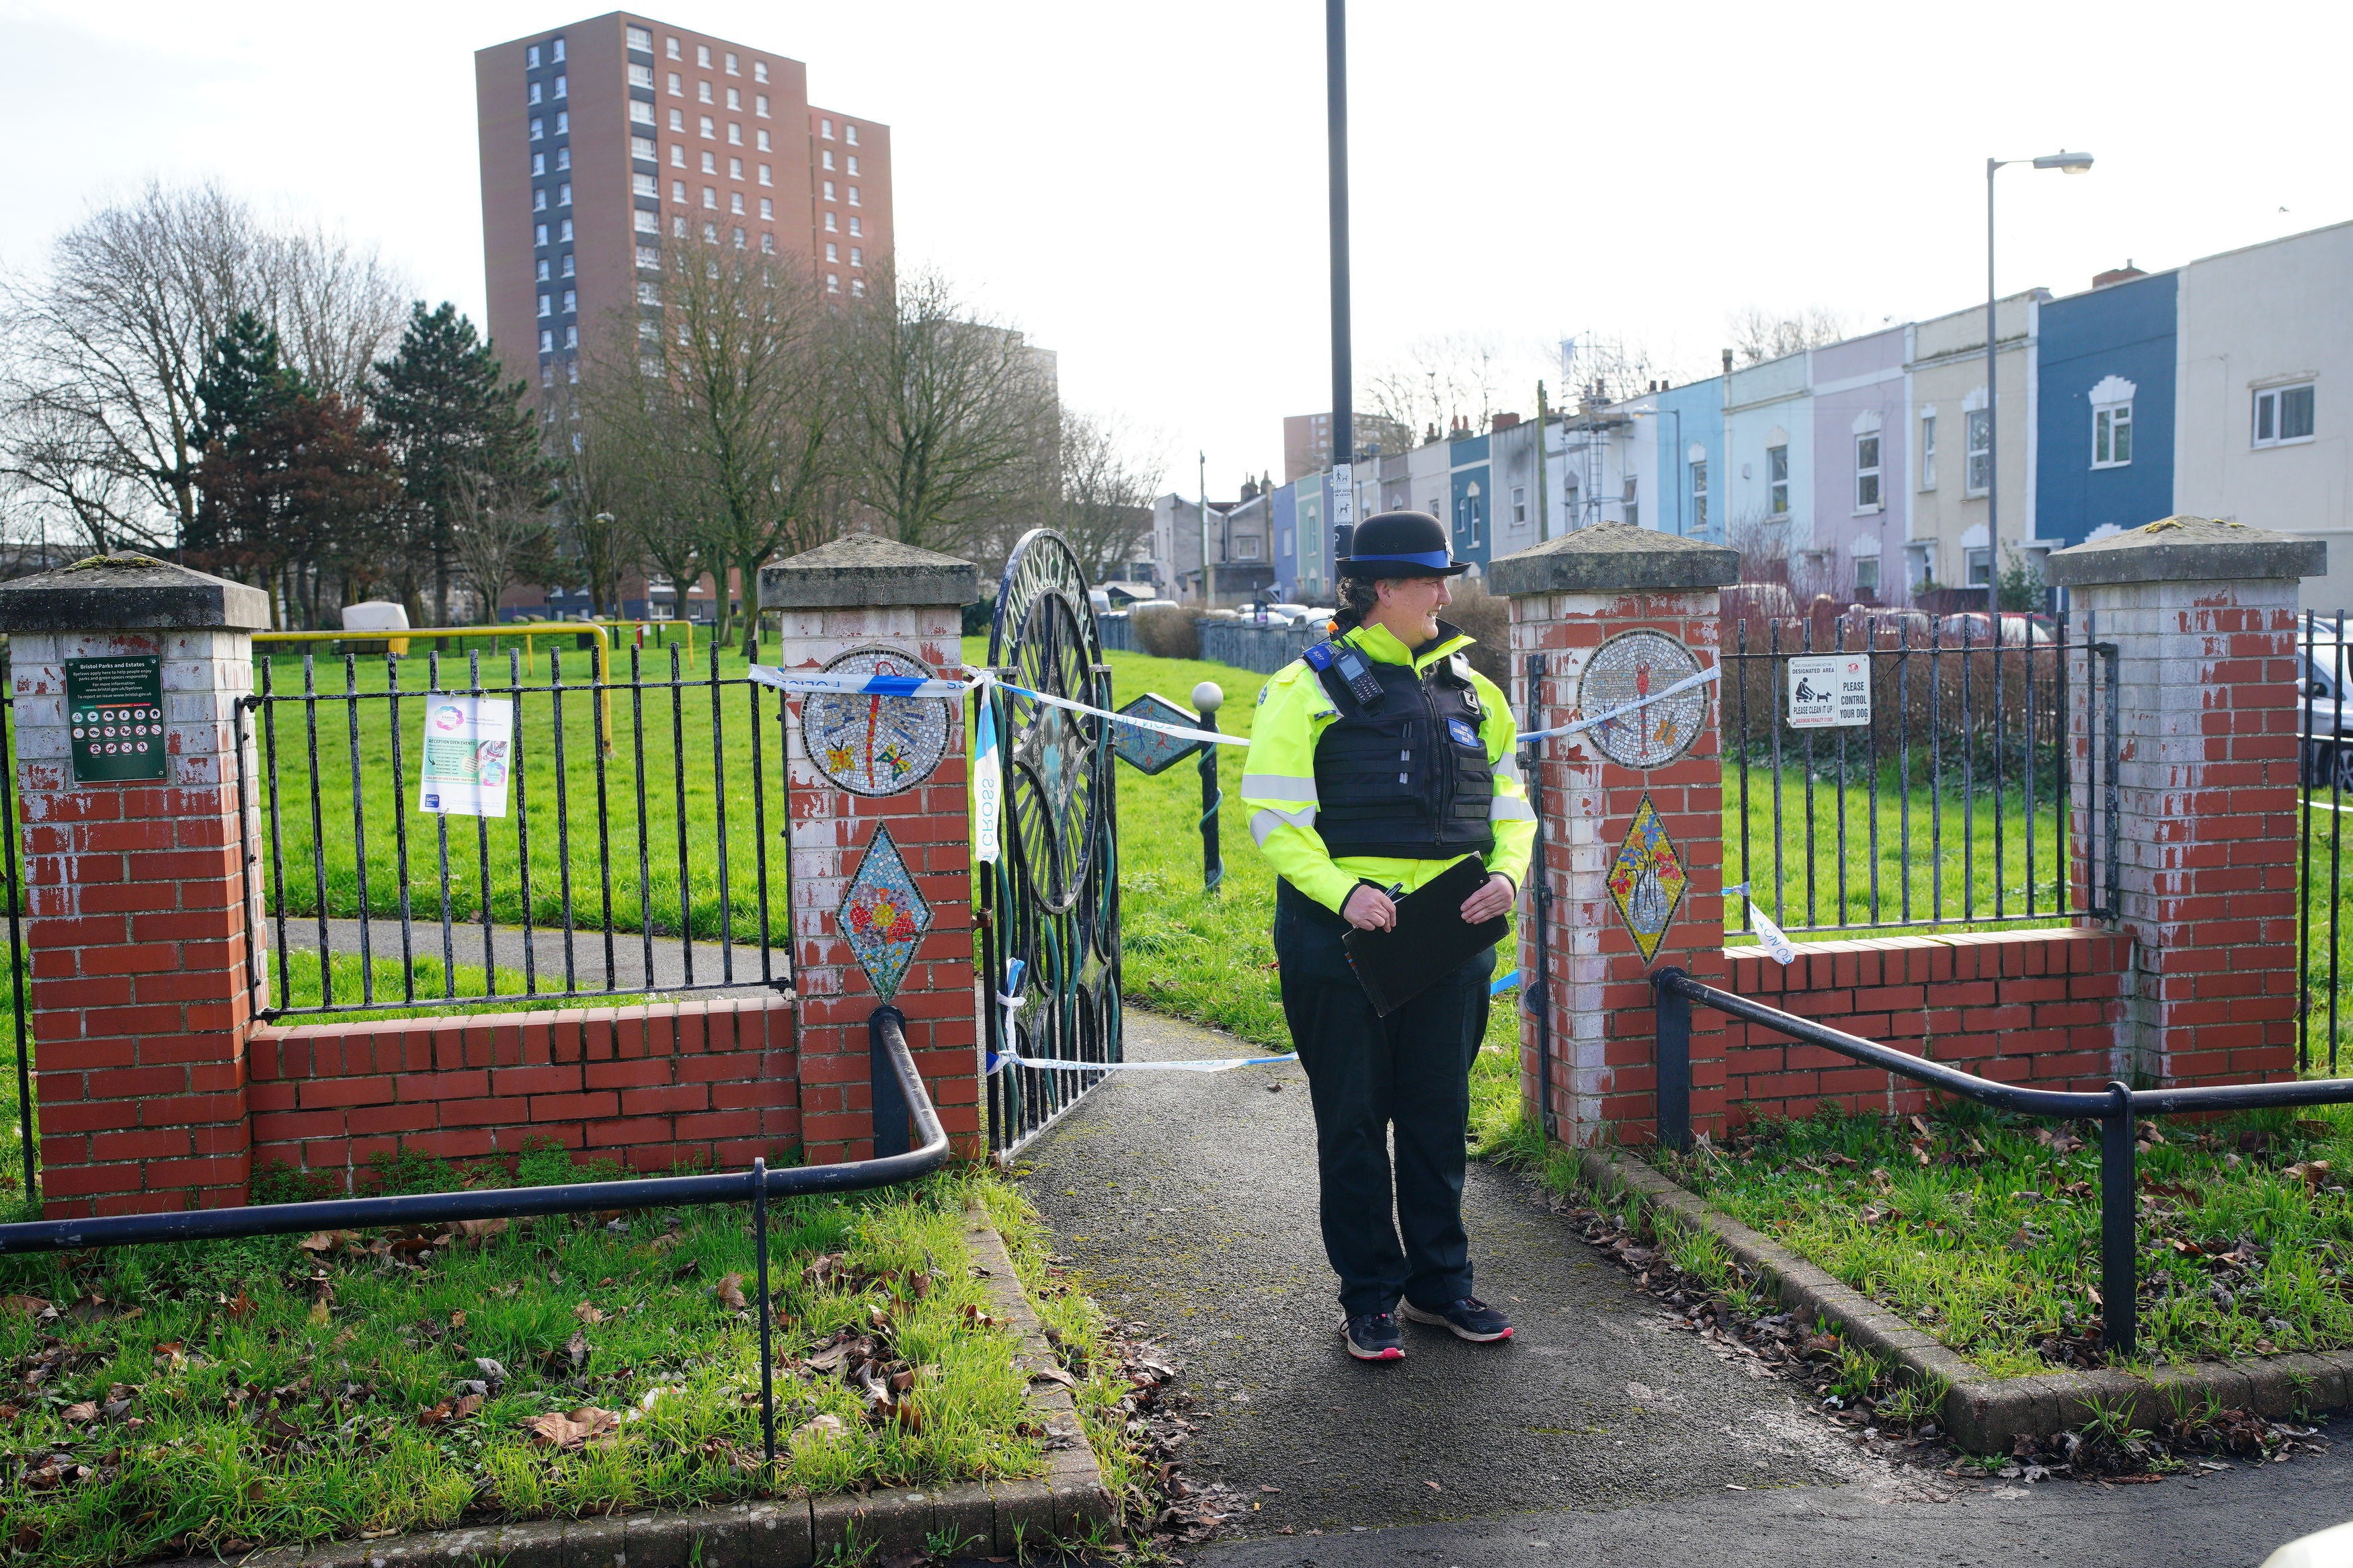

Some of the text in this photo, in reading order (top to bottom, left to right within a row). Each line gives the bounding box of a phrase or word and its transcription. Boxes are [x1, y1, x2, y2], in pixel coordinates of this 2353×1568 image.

[1843, 682, 1864, 691] PLEASE
[1841, 695, 1867, 705] CONTROL
[1793, 706, 1808, 715] PLEASE
[1840, 709, 1868, 718] YOUR DOG
